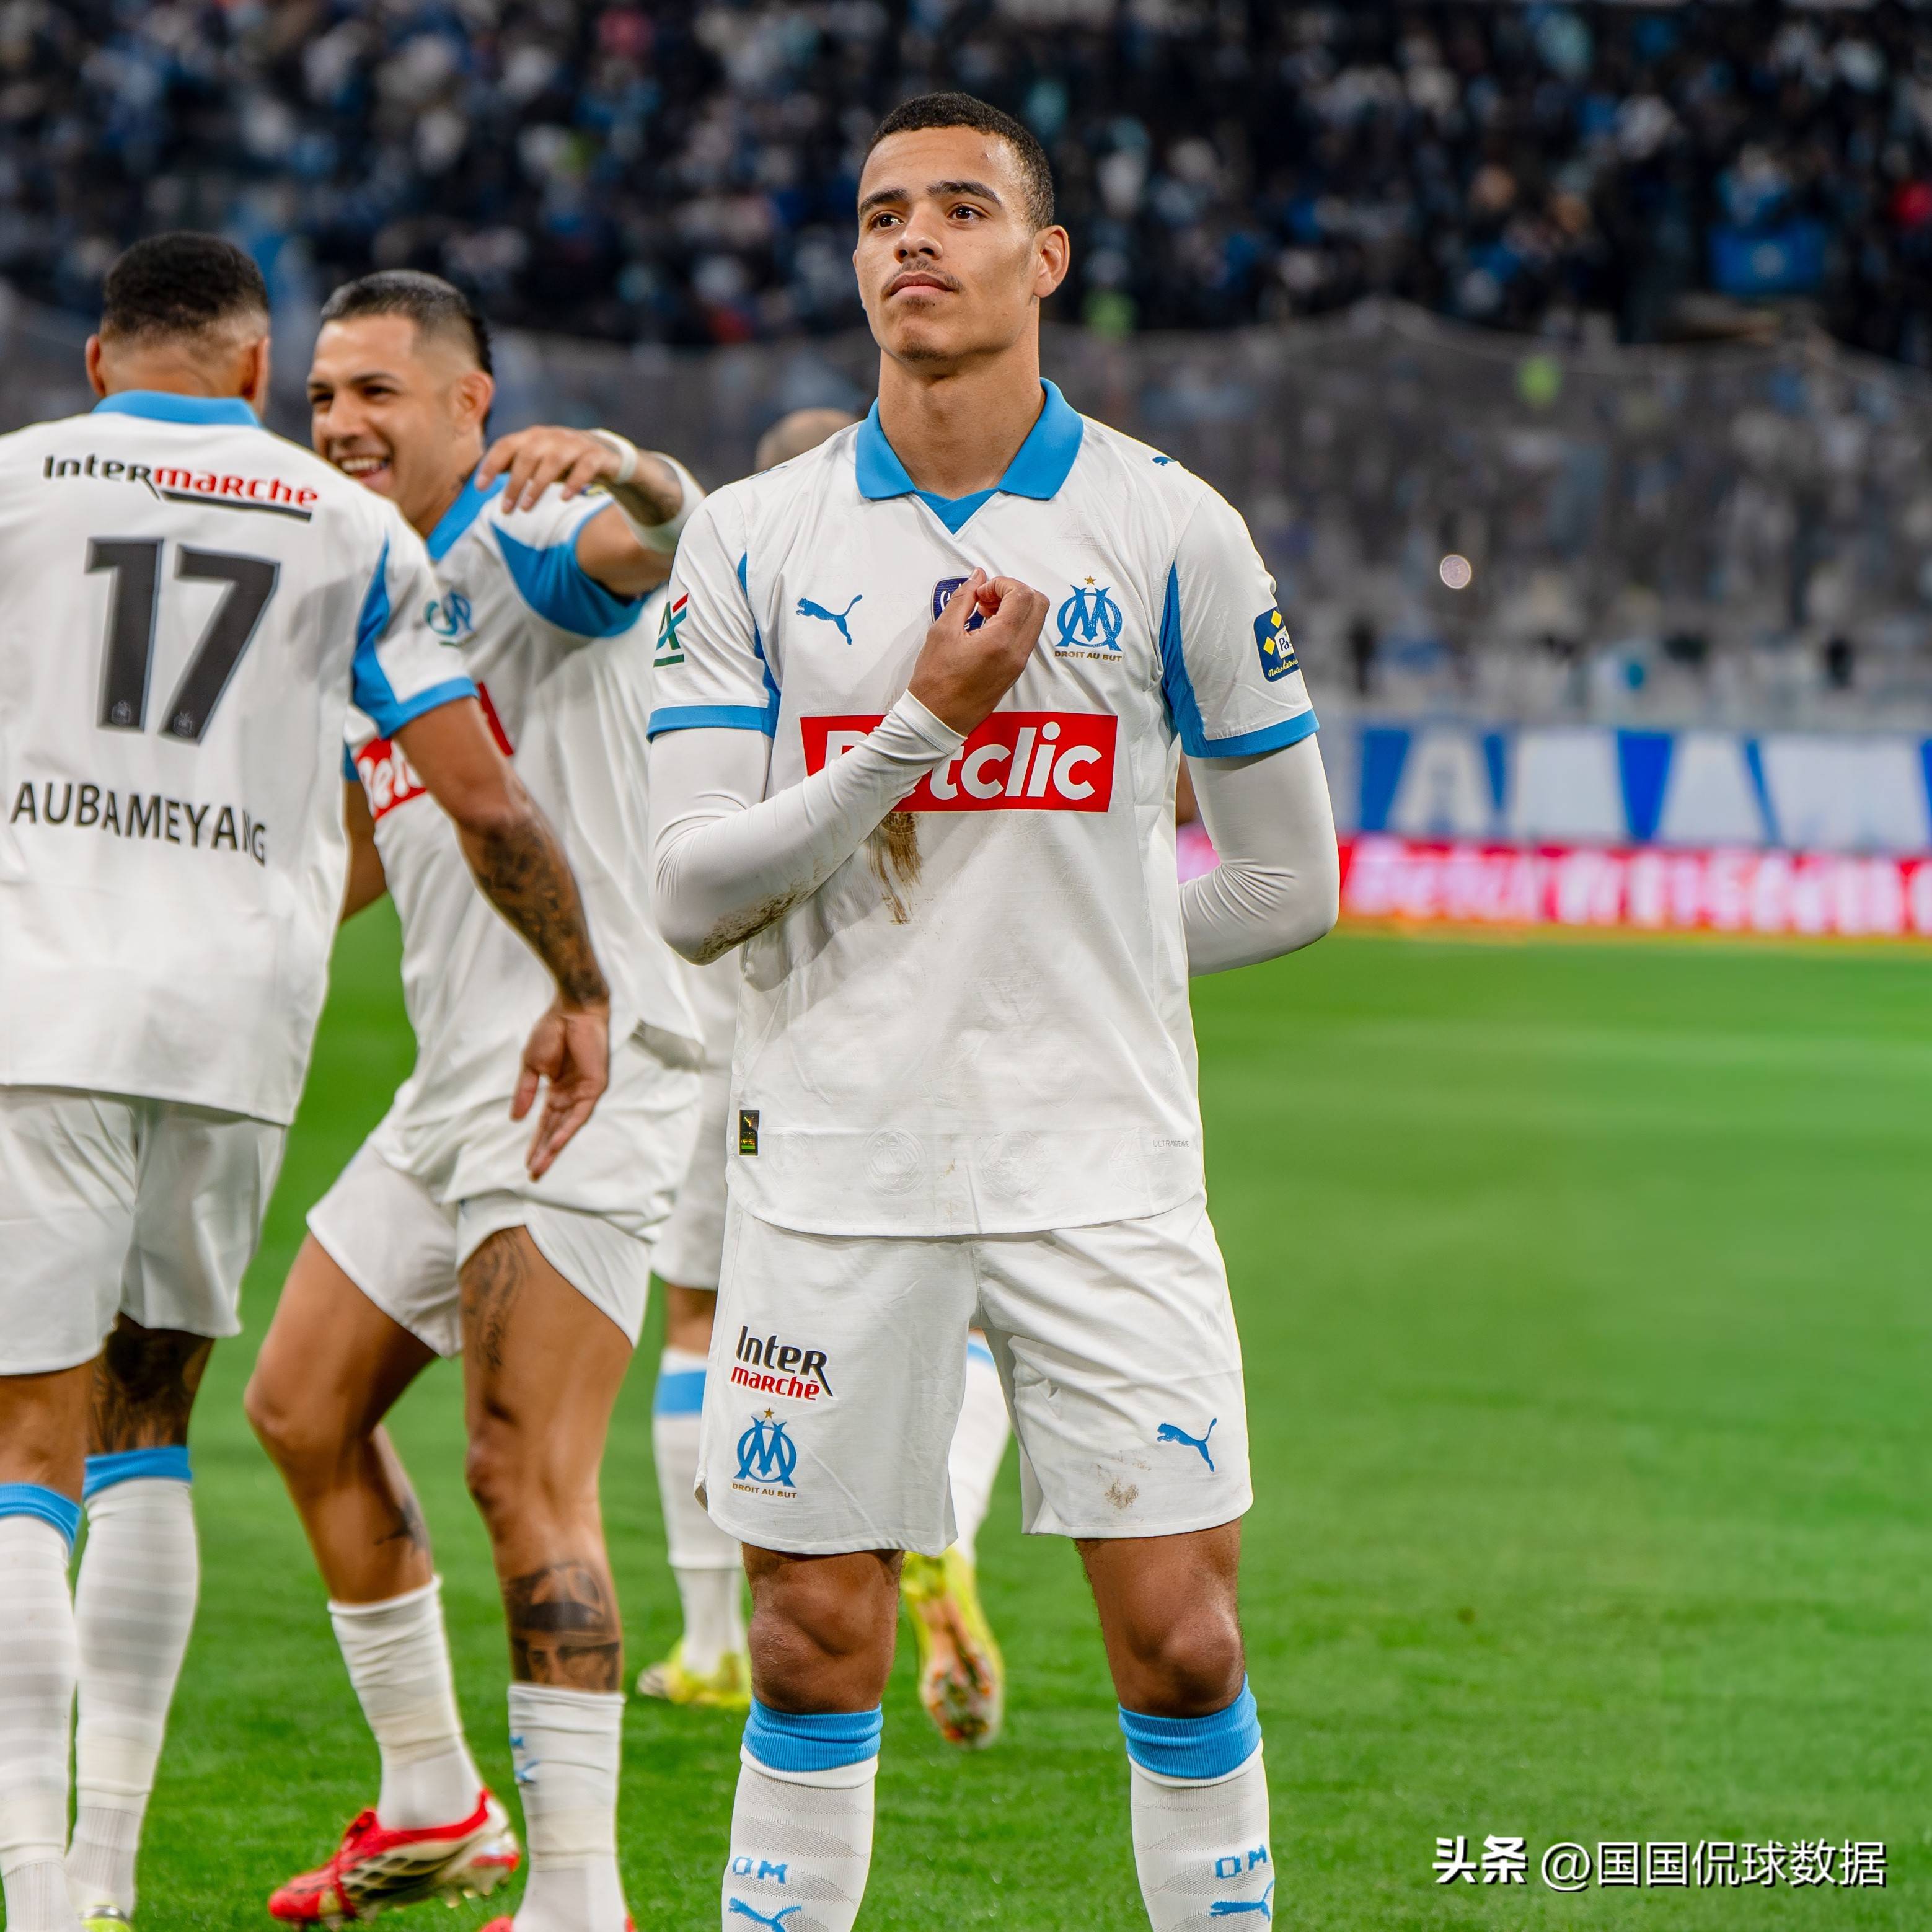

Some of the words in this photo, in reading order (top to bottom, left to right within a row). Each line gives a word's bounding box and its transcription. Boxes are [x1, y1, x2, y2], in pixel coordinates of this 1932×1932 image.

[85, 537, 281, 746] 17
[1103, 654, 1123, 662] BUT
[825, 721, 1102, 800] tclic
[10, 782, 266, 867] AUBAMEYANG
[732, 1483, 759, 1493] DROIT
[732, 1856, 788, 1884] OM
[1215, 1844, 1268, 1879] OM
